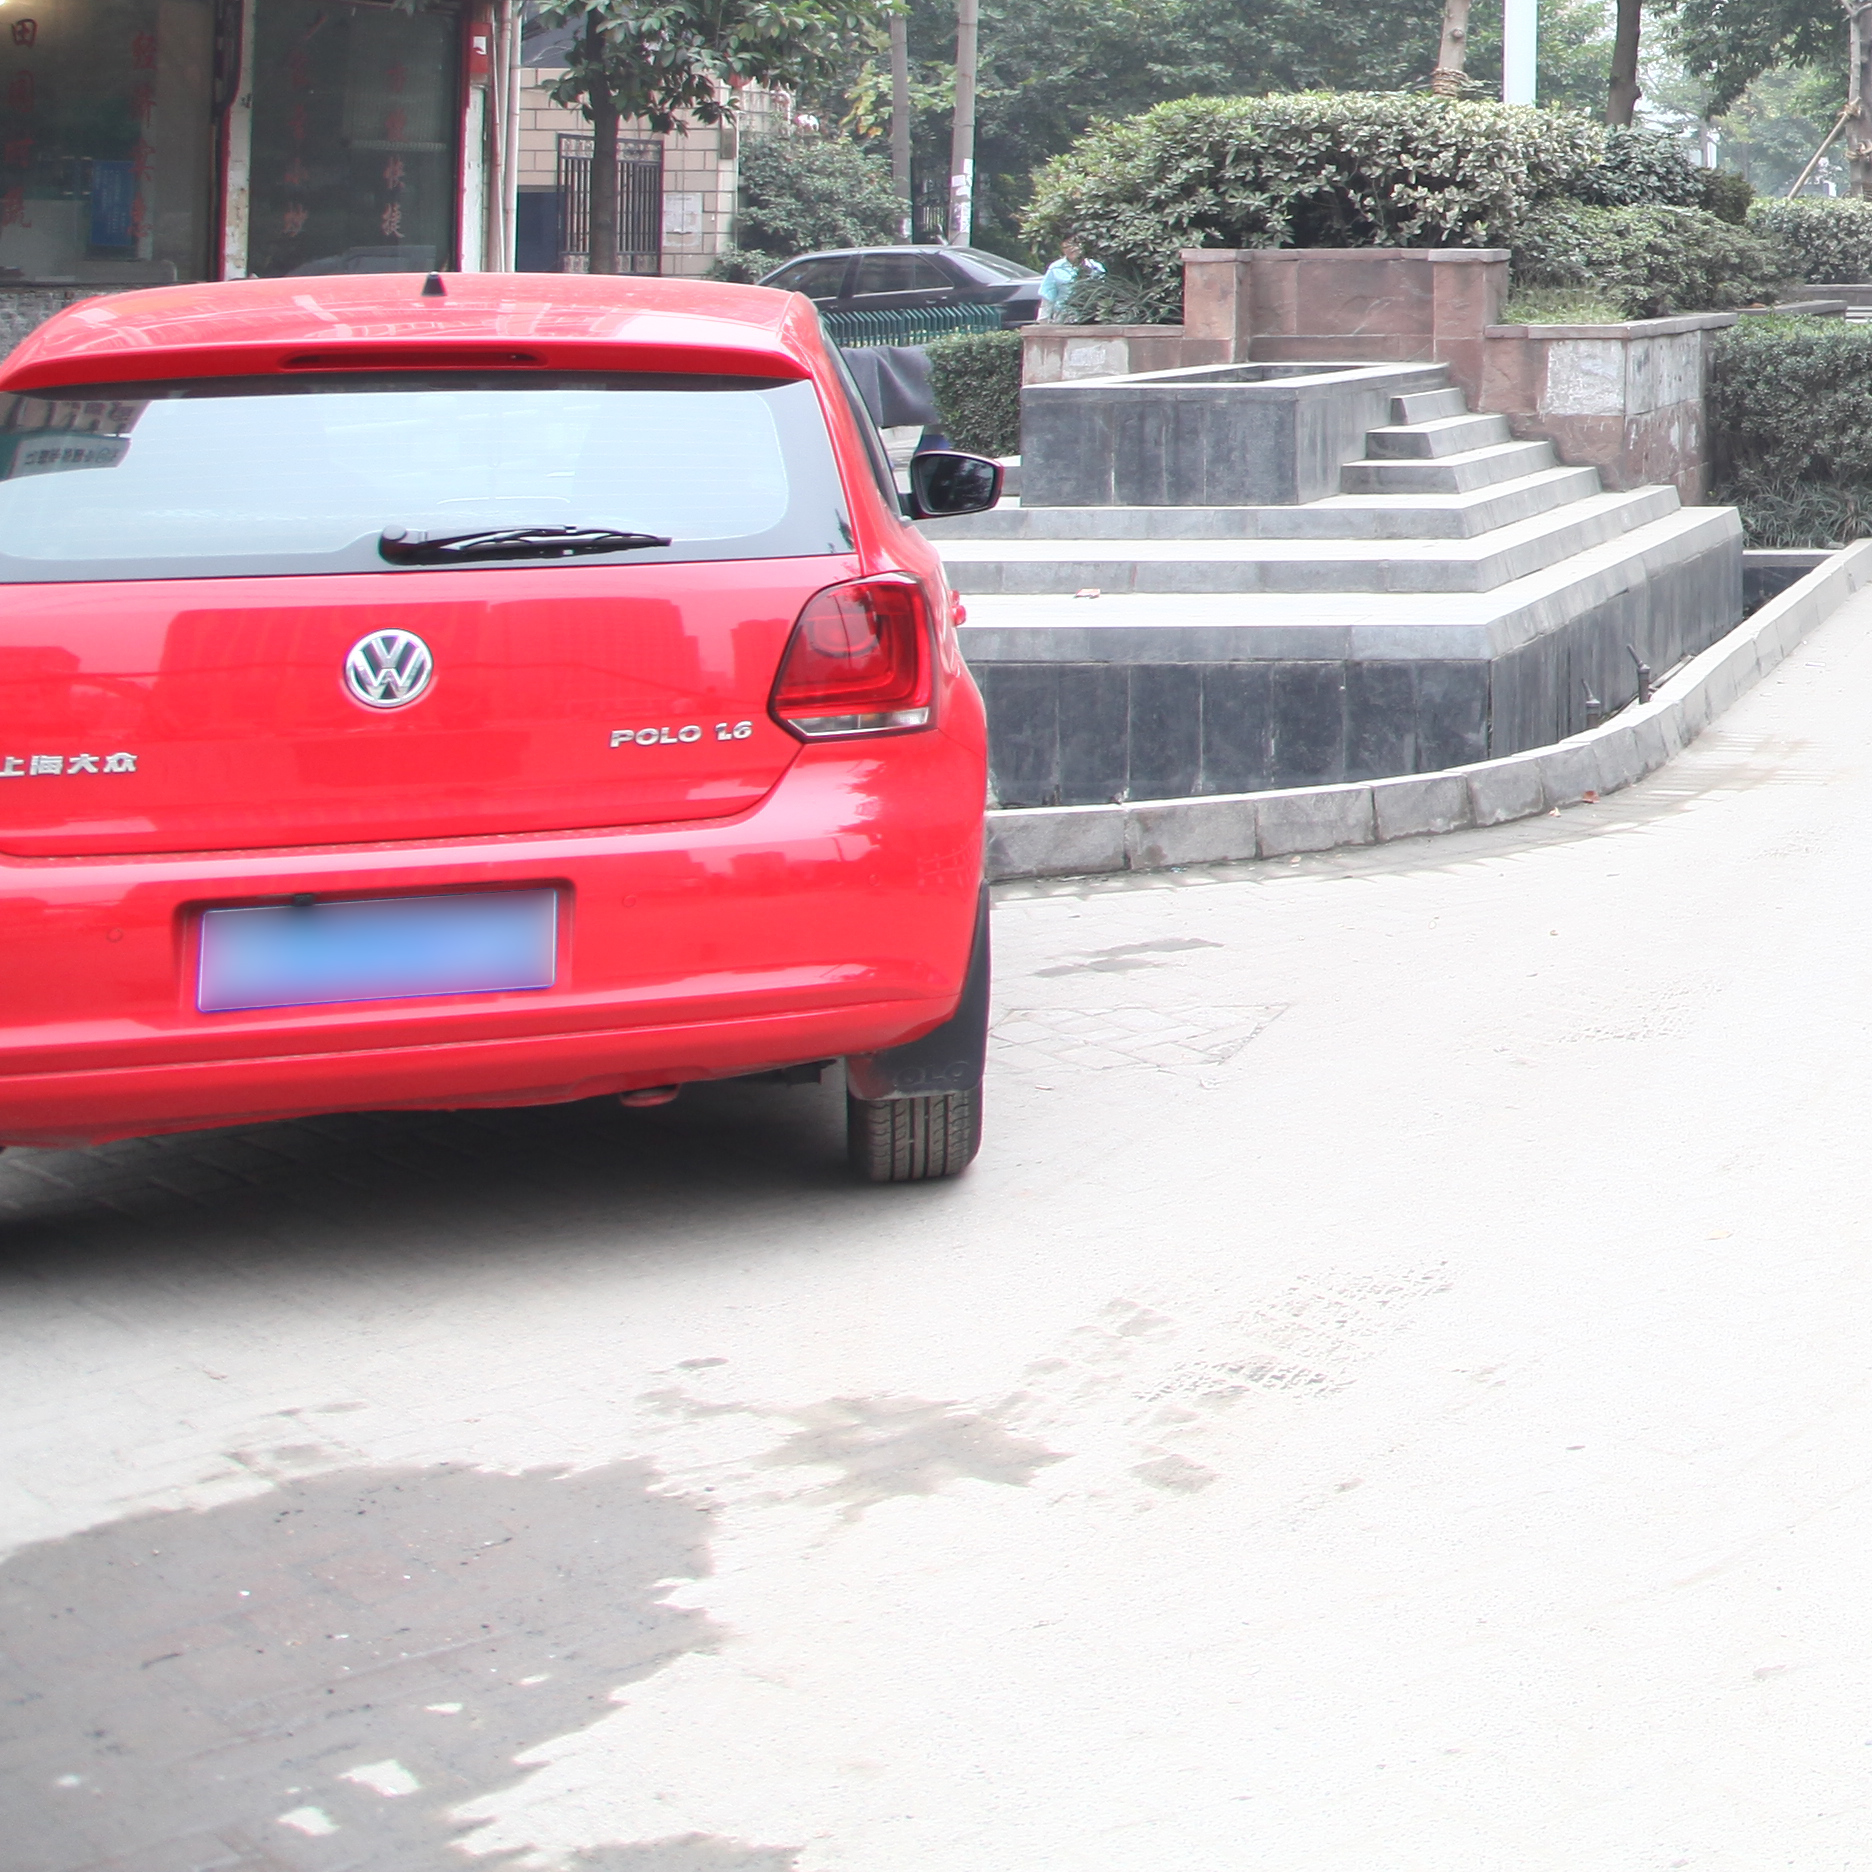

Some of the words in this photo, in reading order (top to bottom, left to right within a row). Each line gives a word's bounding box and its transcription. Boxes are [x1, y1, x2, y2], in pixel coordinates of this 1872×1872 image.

[609, 725, 702, 748] POLO
[0, 752, 138, 778] 上海大众
